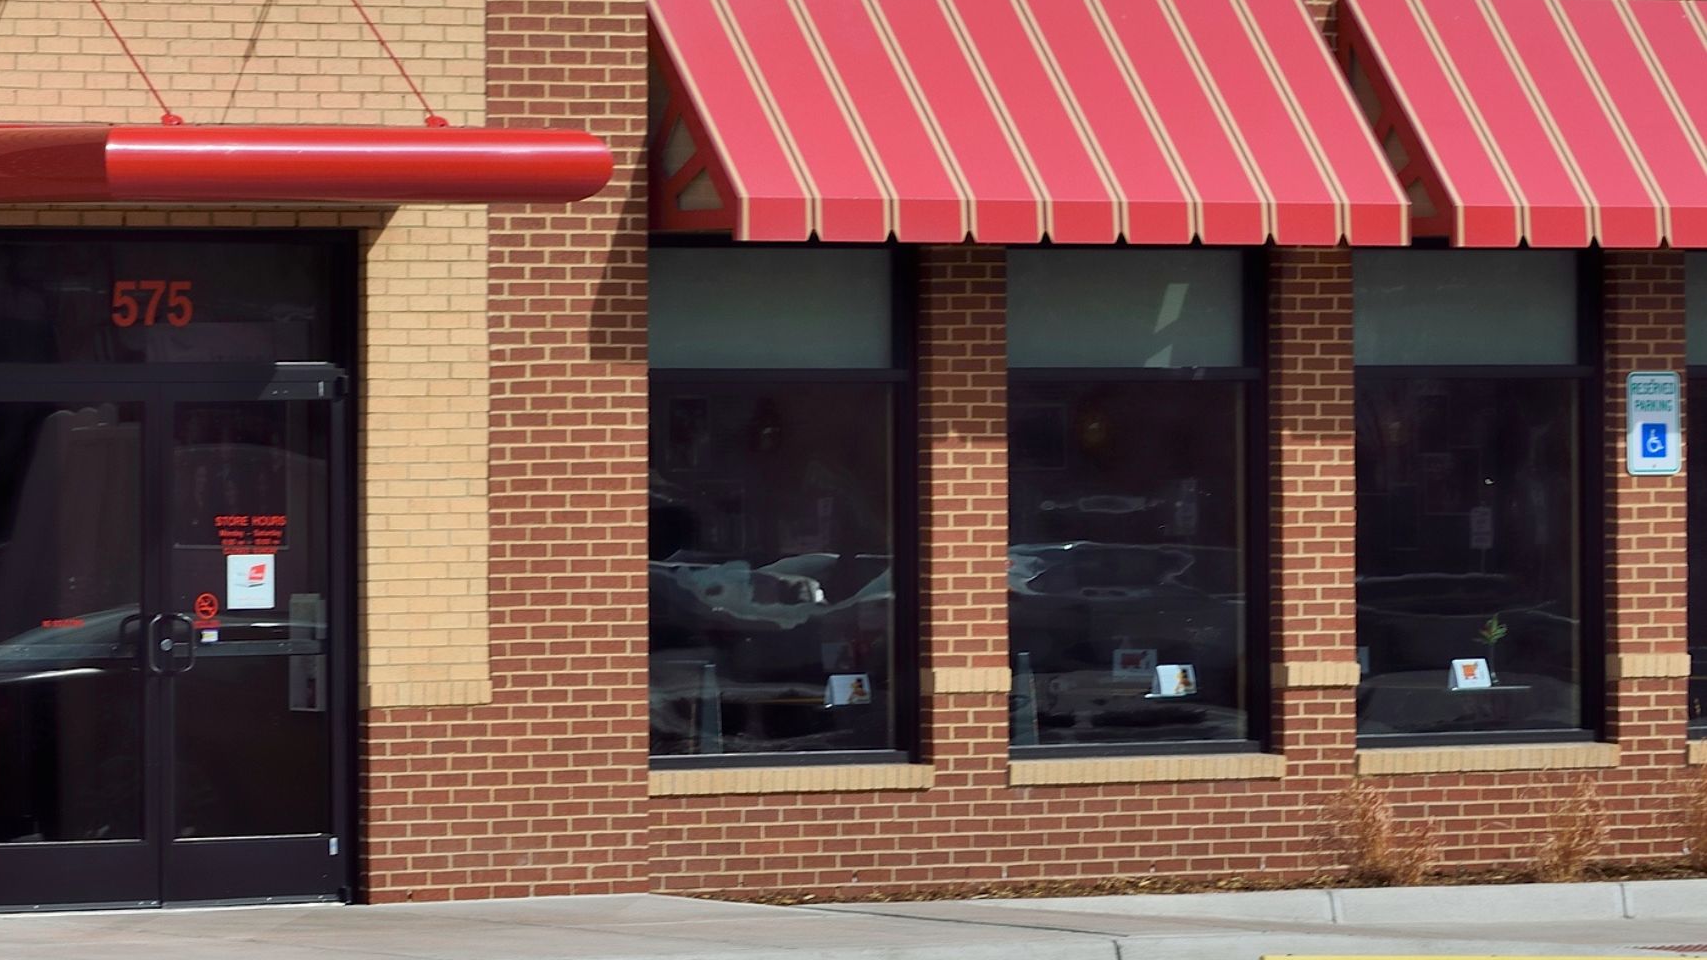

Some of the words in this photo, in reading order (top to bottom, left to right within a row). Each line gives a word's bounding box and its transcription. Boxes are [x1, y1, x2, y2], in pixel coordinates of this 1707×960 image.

[112, 280, 193, 328] 575
[1631, 382, 1676, 395] RESERVED
[1634, 399, 1672, 412] PARKING
[214, 515, 249, 527] STORE
[251, 515, 287, 527] HOURS
